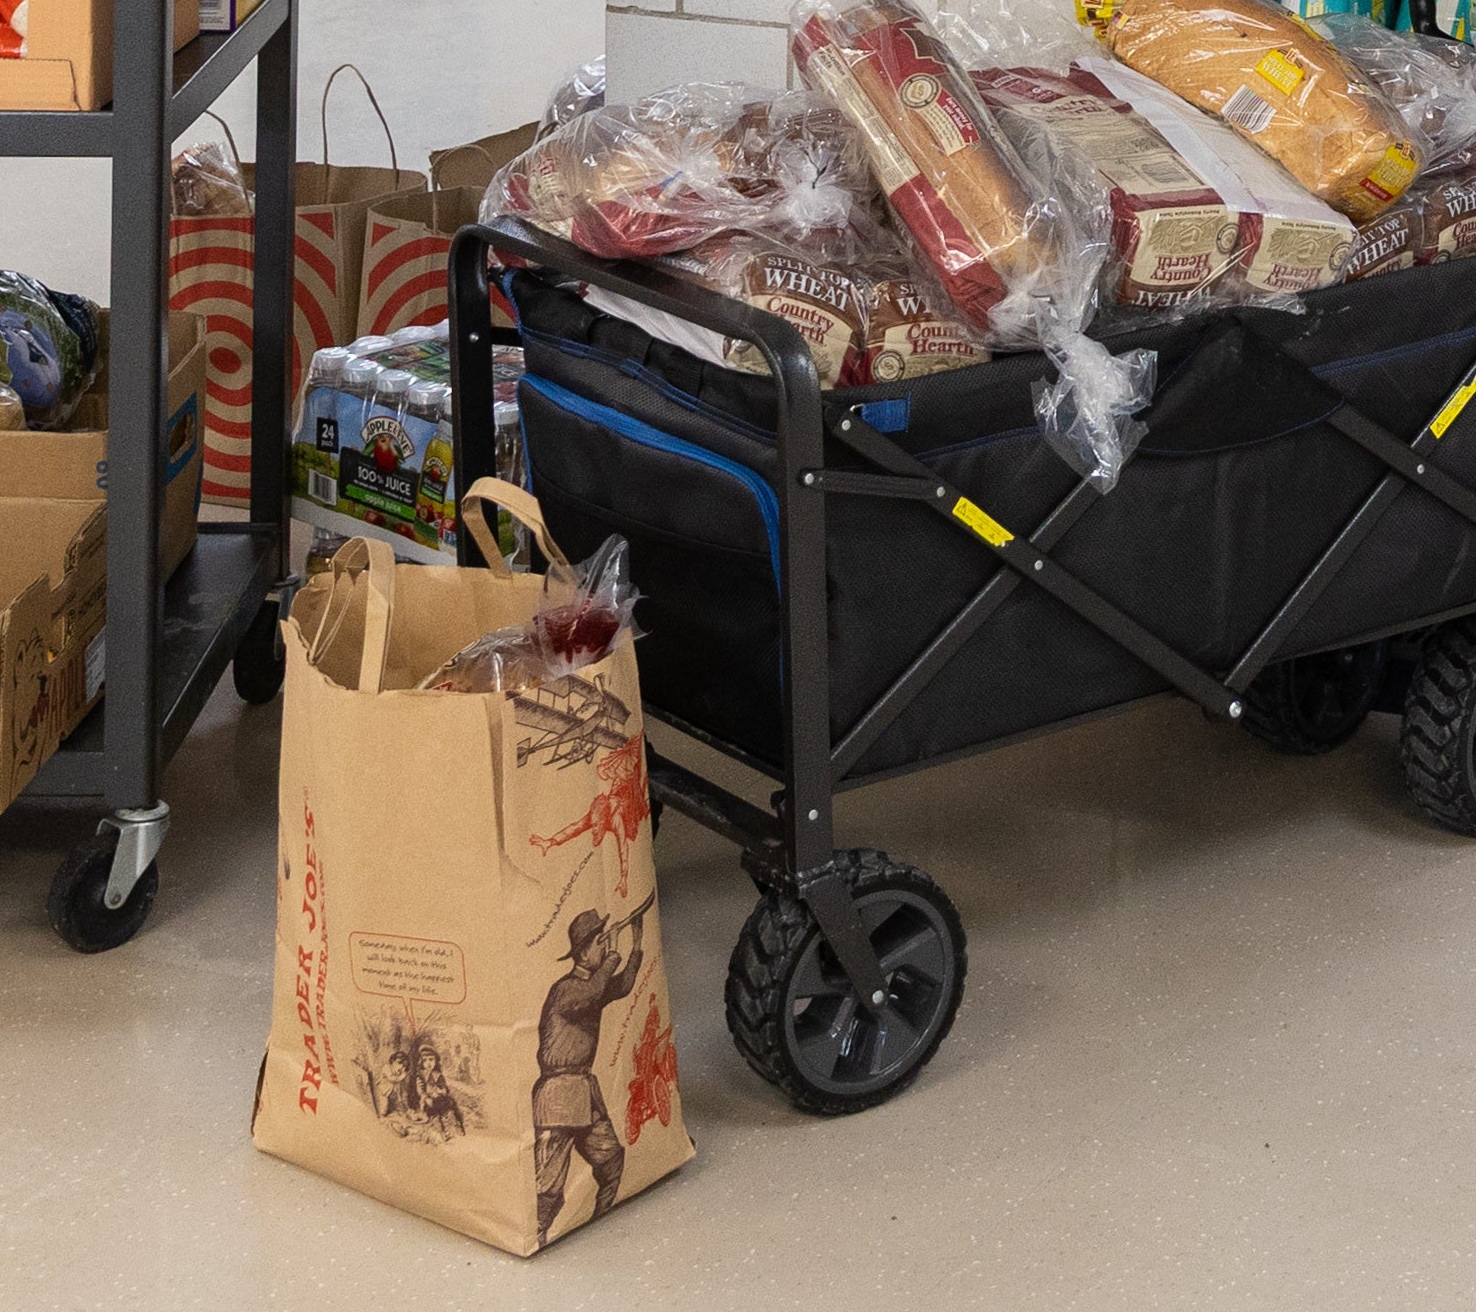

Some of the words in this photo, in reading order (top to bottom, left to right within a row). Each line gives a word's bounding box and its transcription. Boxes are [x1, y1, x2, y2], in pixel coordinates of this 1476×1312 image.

[763, 267, 853, 313] WHEAT
[1150, 265, 1212, 284] Country
[1131, 287, 1211, 309] WHEAT
[765, 295, 835, 335] Country
[321, 423, 335, 440] 24
[357, 465, 384, 486] 100%
[385, 475, 412, 497] JUICE
[364, 493, 384, 506] apple
[385, 498, 402, 513] juice
[298, 803, 318, 933] JOE'S
[297, 953, 319, 1116] TRADER
